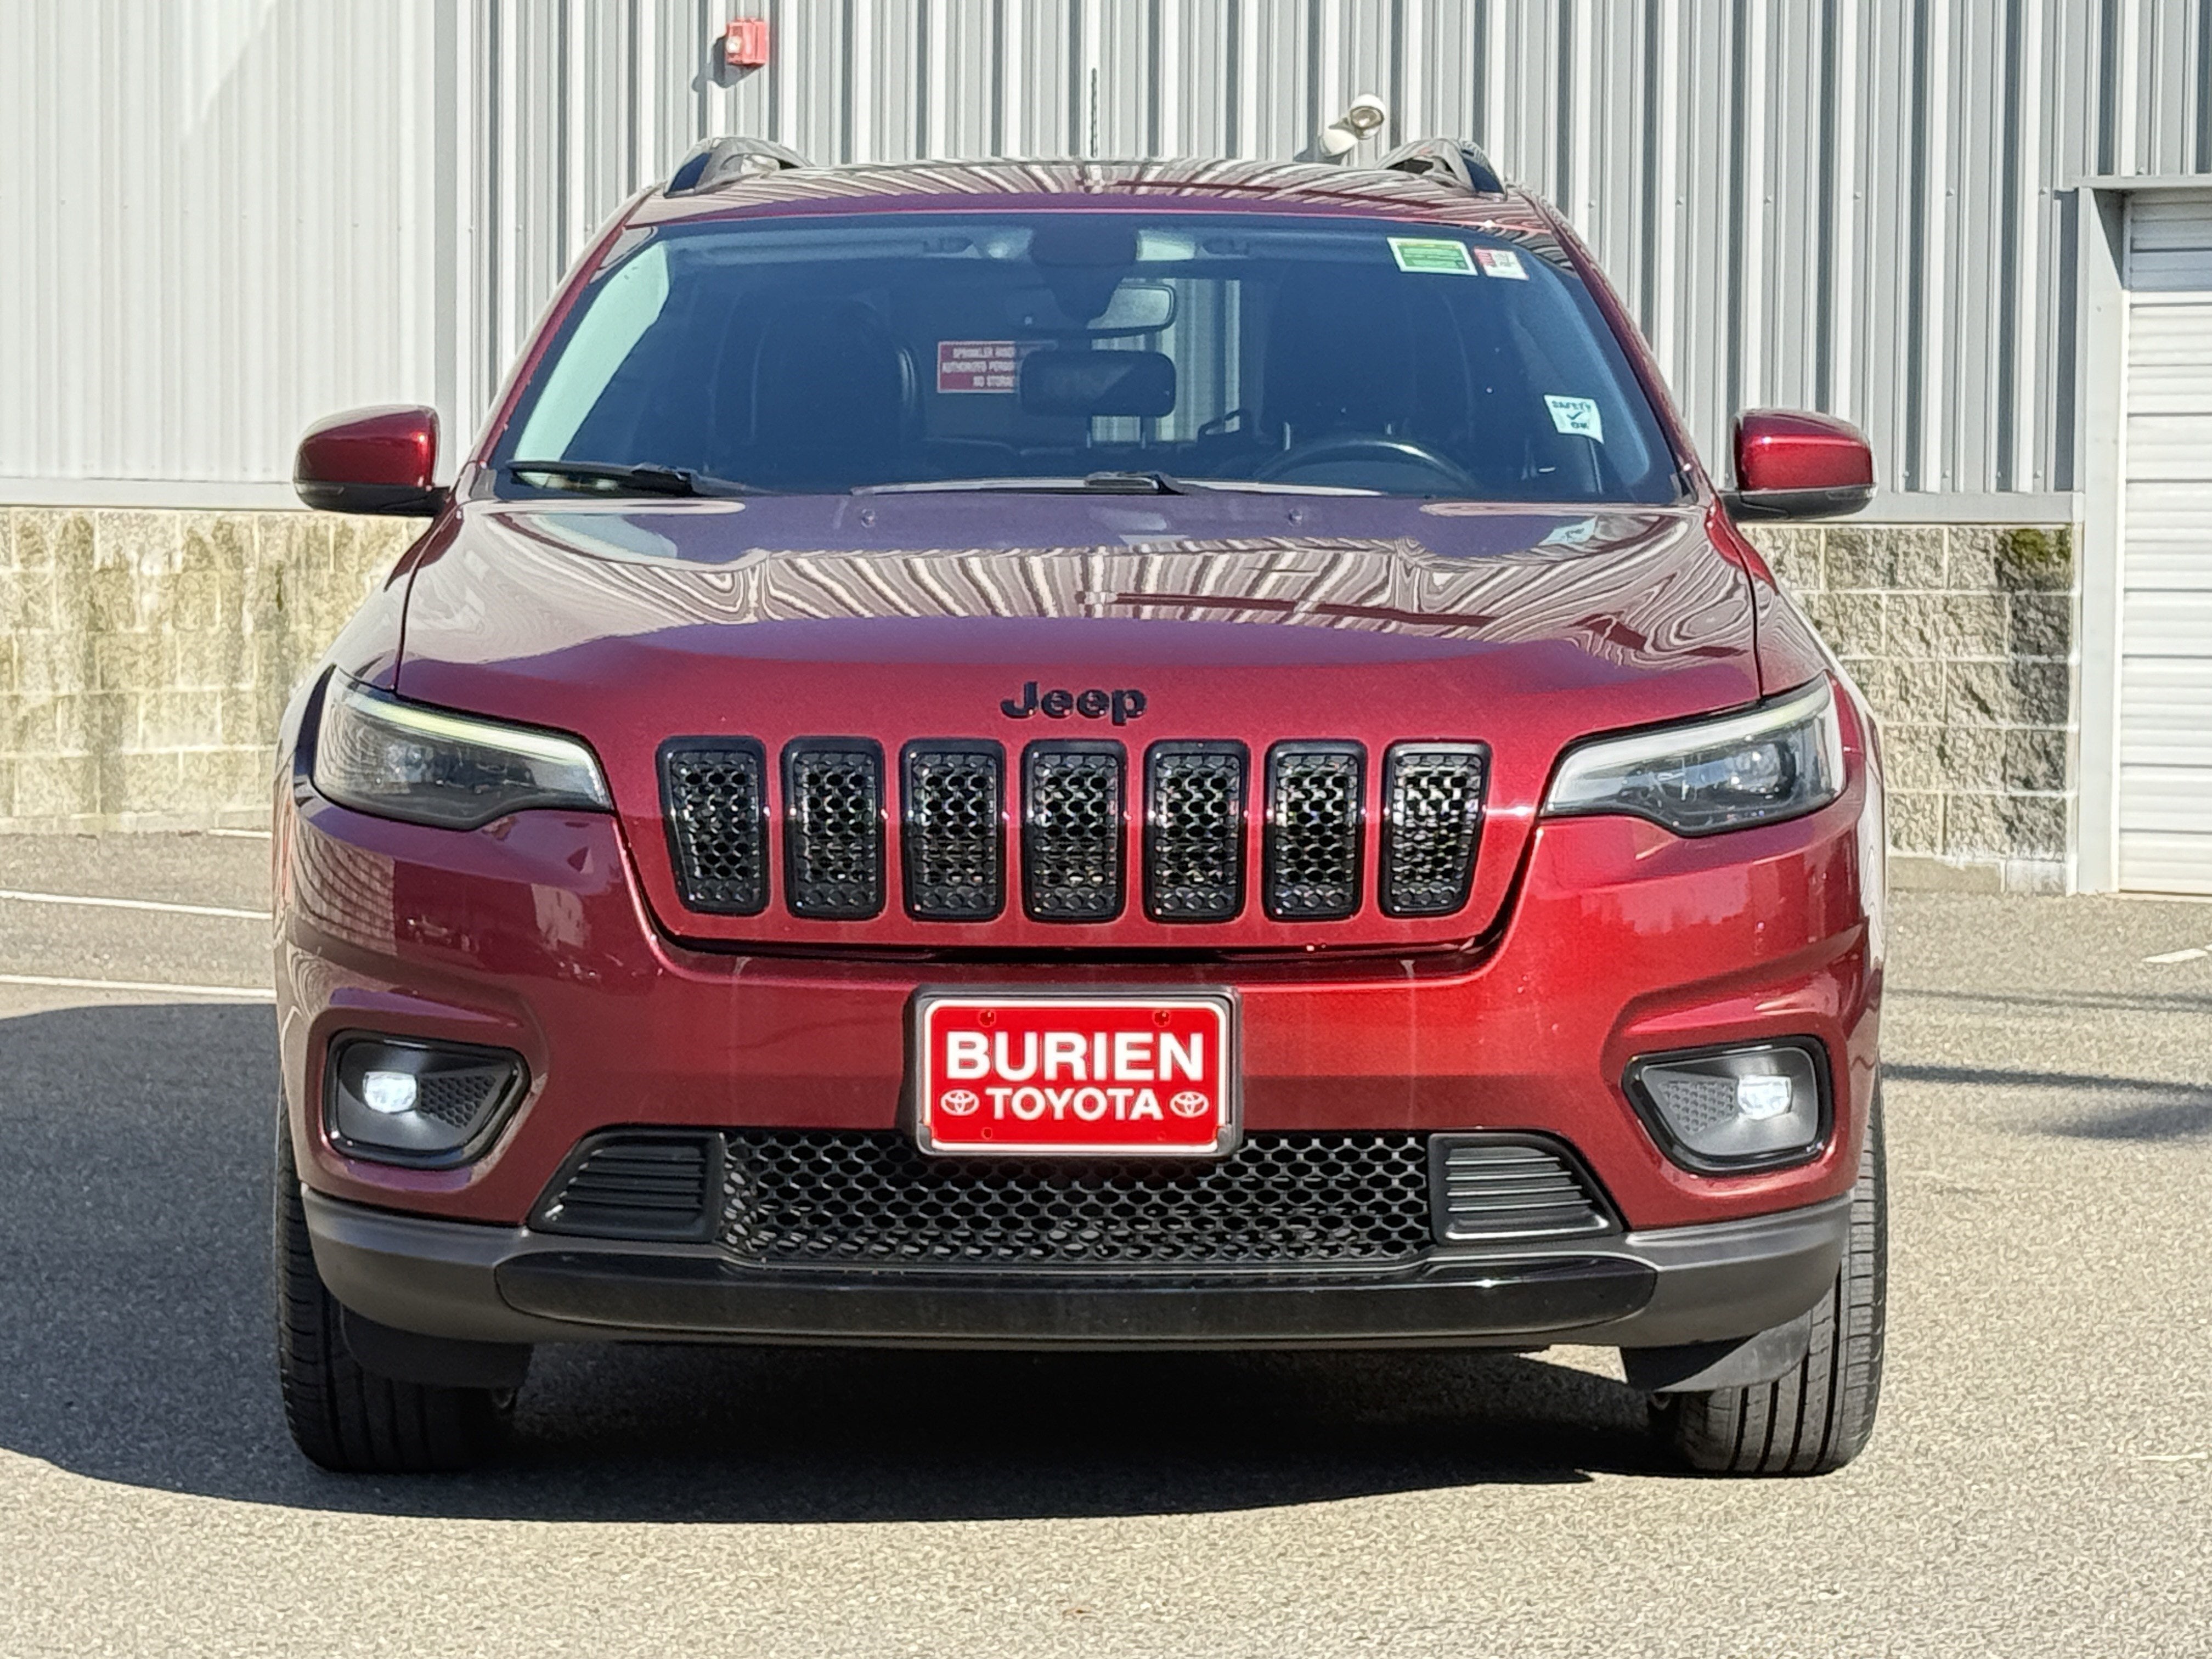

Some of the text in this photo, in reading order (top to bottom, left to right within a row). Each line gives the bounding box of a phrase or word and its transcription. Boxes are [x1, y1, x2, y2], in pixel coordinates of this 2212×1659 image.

[1551, 400, 1590, 411] SAFETY
[1000, 681, 1147, 726] Jeep
[946, 1030, 1204, 1082] BURIEN
[985, 1087, 1164, 1121] TOYOTA
